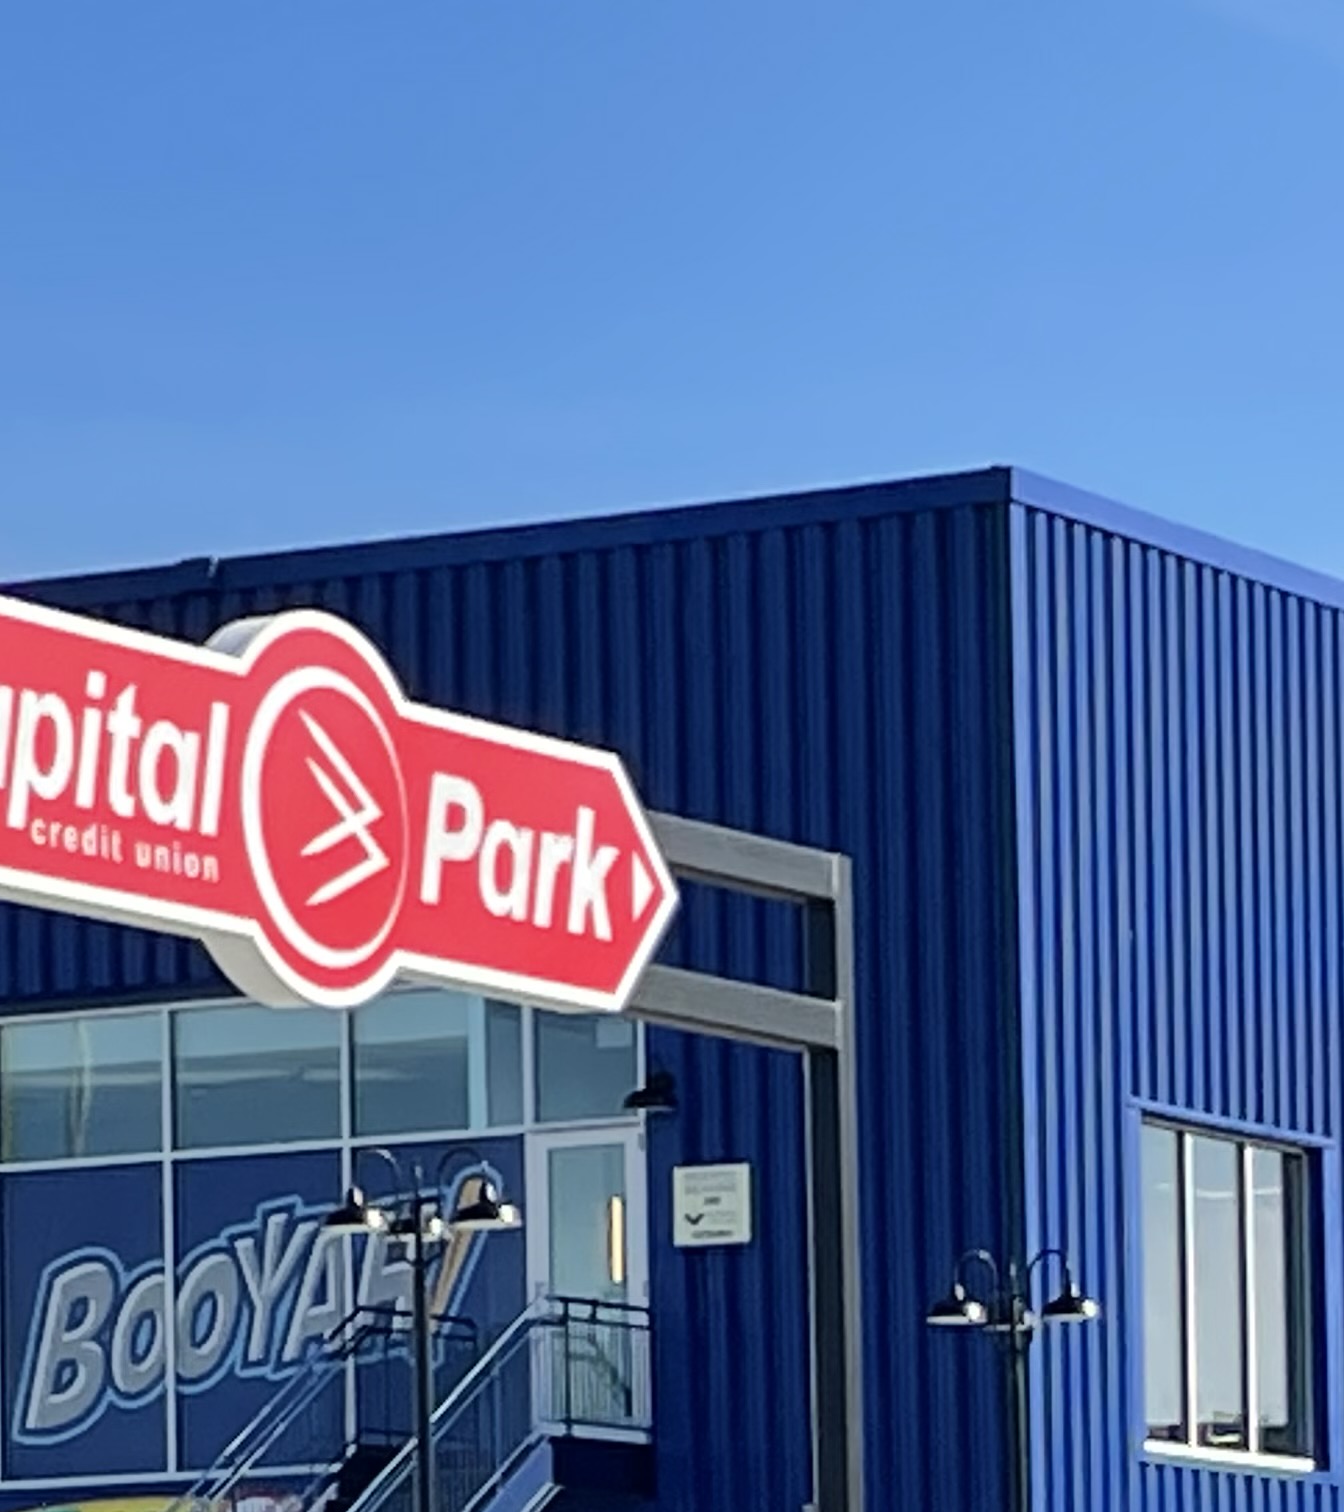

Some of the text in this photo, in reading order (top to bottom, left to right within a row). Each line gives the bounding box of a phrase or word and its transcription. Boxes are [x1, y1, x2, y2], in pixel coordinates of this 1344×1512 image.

[31, 820, 220, 883] credit union
[420, 771, 620, 941] Park
